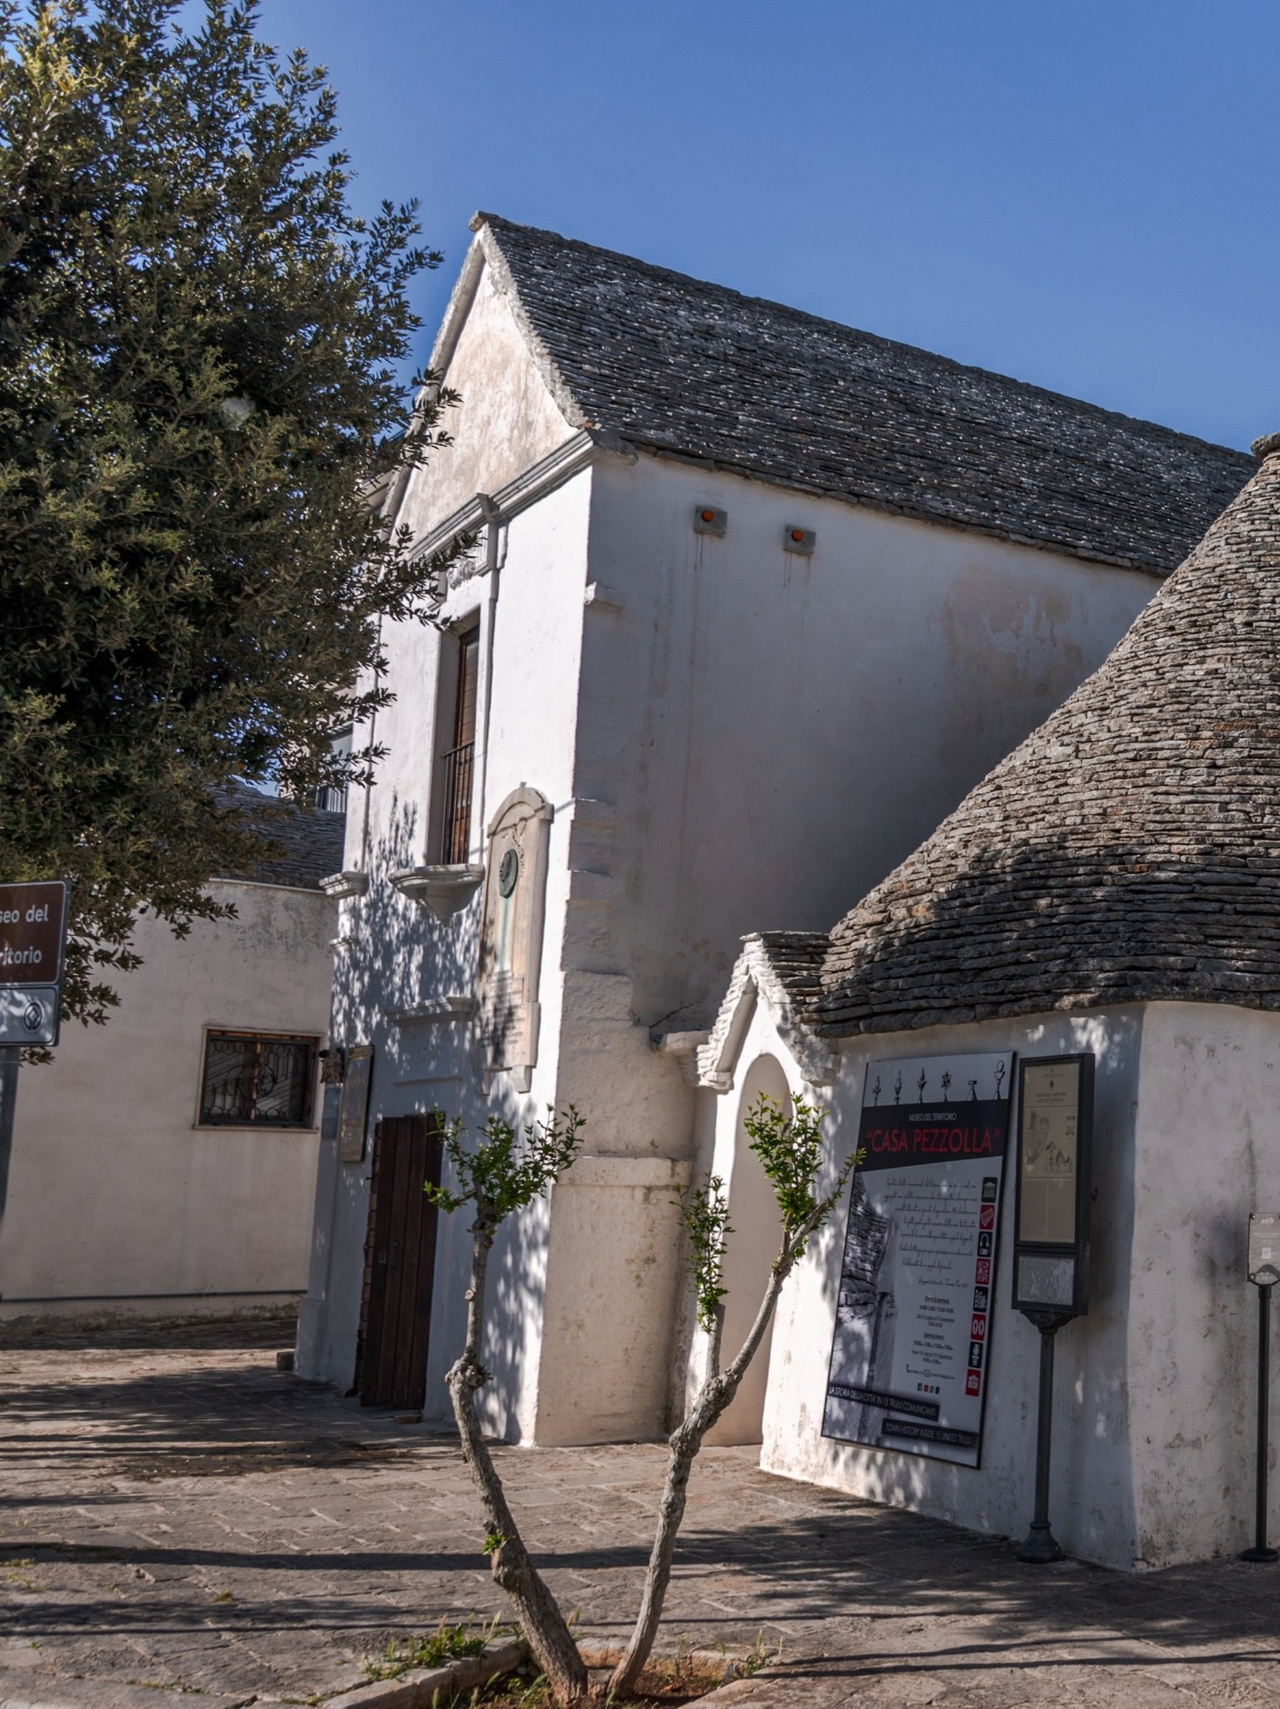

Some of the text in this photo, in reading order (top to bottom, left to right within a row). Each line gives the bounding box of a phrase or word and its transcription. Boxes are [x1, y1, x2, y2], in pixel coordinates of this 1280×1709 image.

[25, 904, 49, 922] del
[908, 1112, 957, 1121] MUSEO DEL TERRITORIO
[835, 1387, 850, 1397] STORIA
[850, 1389, 863, 1400] DELLA
[889, 1398, 902, 1409] TRULLI
[902, 1401, 936, 1416] COMUNICANTI
